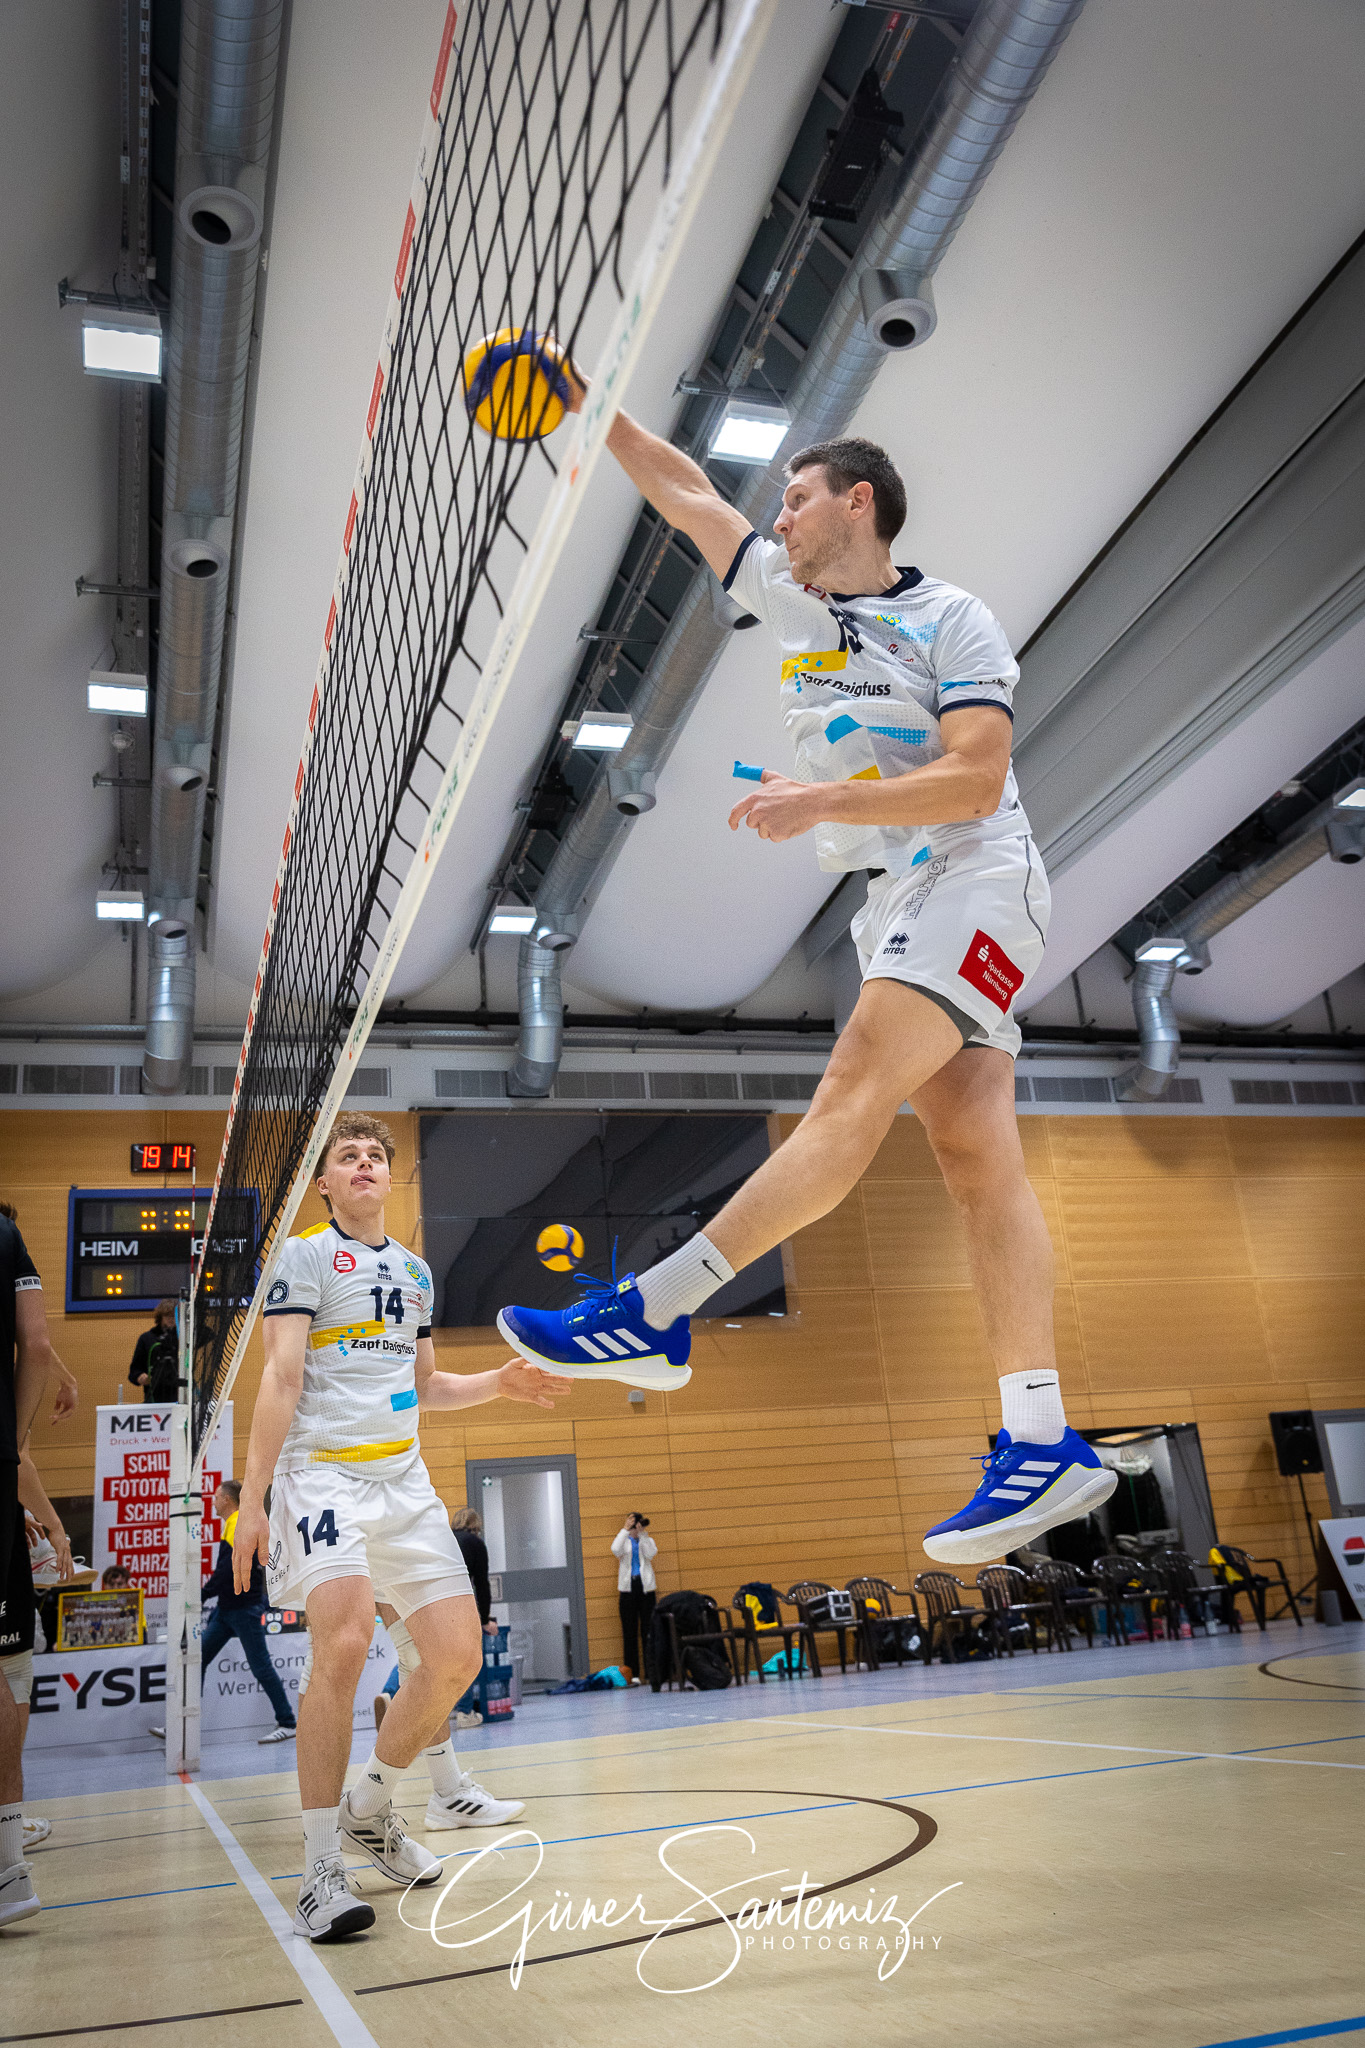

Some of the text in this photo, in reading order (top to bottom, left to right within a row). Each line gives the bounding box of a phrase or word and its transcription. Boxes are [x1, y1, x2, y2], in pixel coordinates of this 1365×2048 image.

[832, 680, 891, 698] Daigfuss
[987, 959, 1014, 989] Sparkasse
[982, 970, 1008, 1001] Nürnberg
[142, 1146, 191, 1168] 19 14
[80, 1240, 139, 1257] HEIM
[369, 1285, 405, 1324] 14
[350, 1339, 380, 1350] Zapf
[111, 1413, 172, 1433] MEY
[128, 1453, 170, 1474] SCHIL
[297, 1509, 340, 1556] 14
[0, 1631, 21, 1645] RAL
[30, 1664, 166, 1714] EYSE
[0, 1813, 22, 1823] AKO
